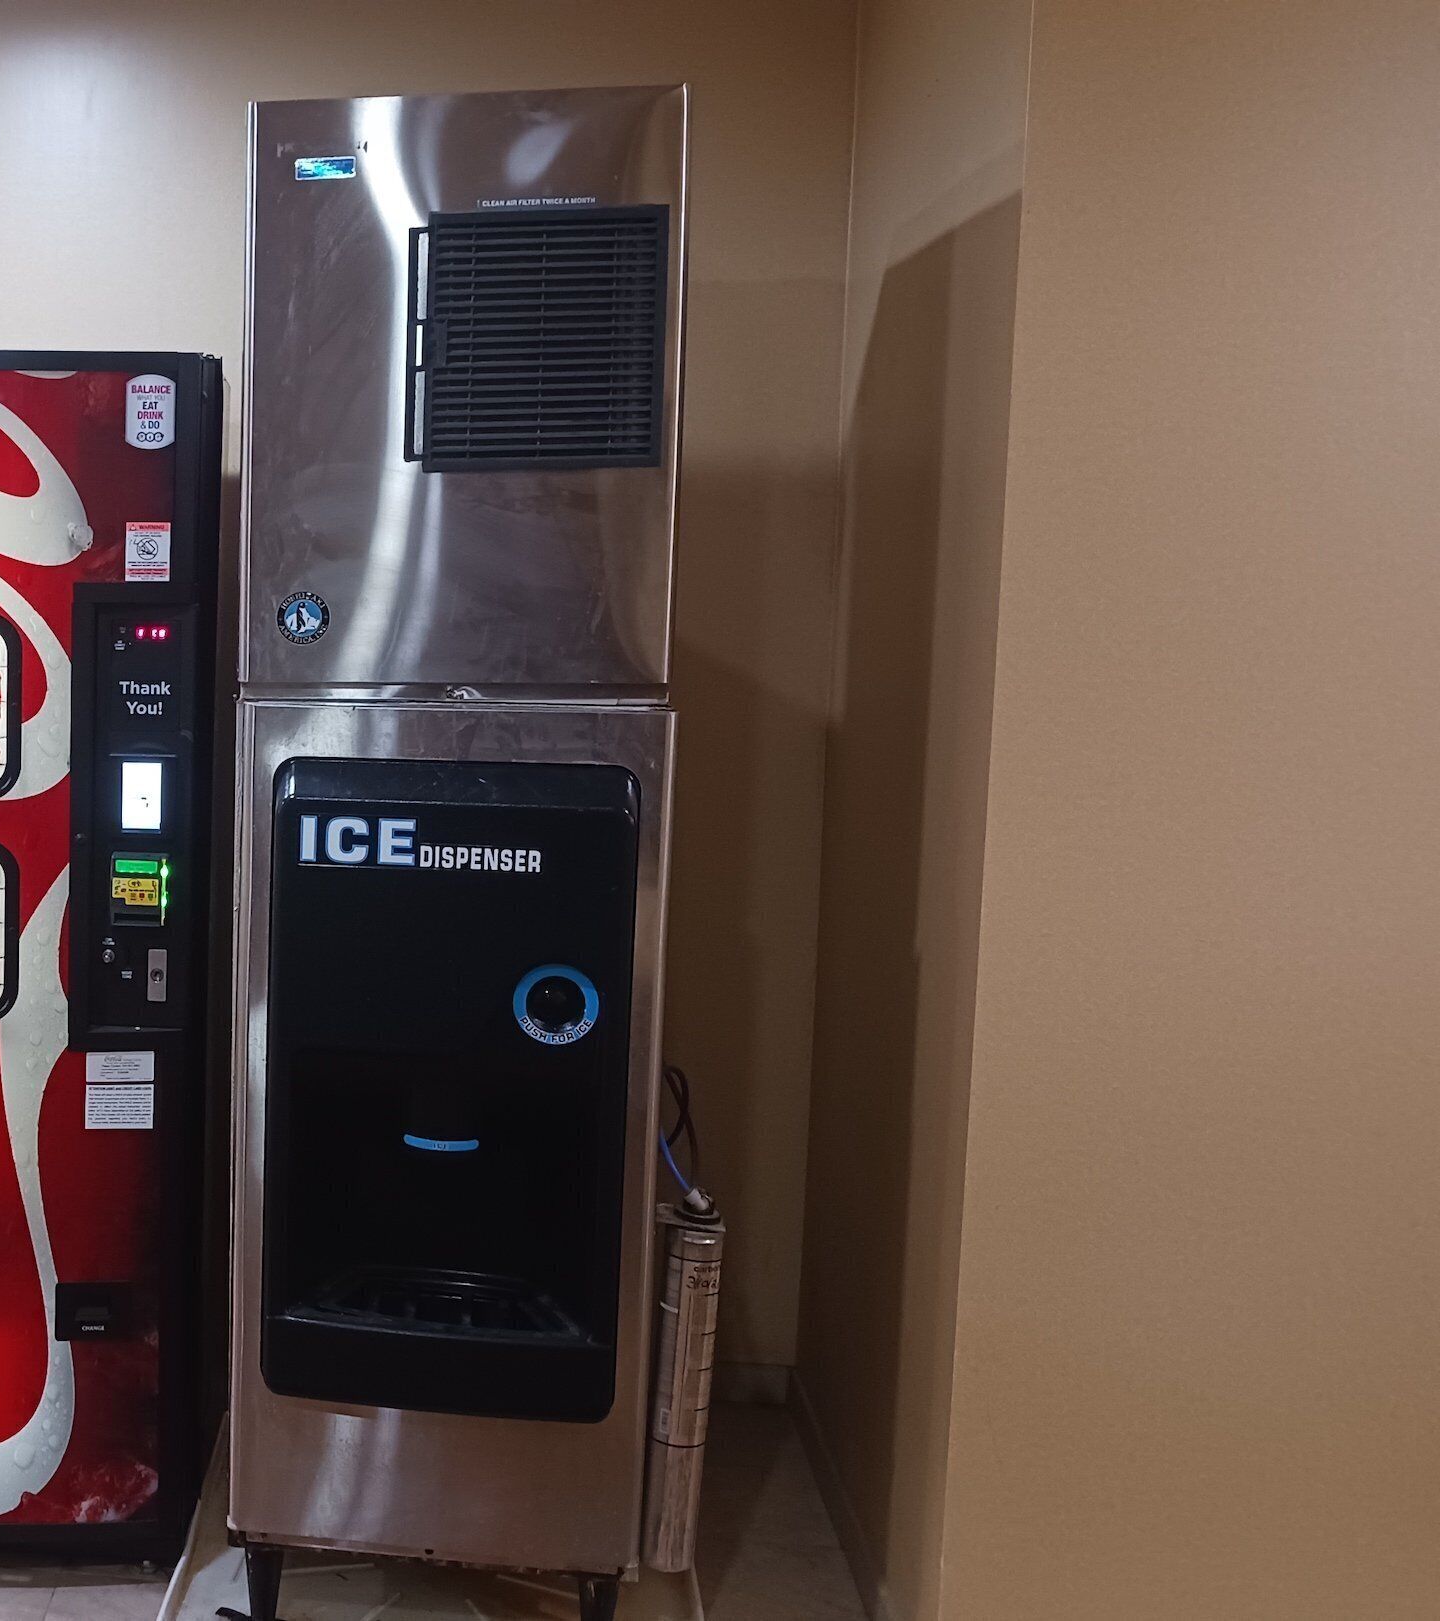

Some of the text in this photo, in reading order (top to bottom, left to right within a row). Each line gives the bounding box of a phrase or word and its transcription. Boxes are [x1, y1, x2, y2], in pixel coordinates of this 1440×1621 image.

[506, 198, 518, 206] AIR
[518, 198, 540, 206] FILTER
[131, 385, 171, 394] BALANCE
[142, 402, 158, 410] EAT
[138, 411, 164, 420] DRINK
[140, 420, 160, 429] & DO
[119, 681, 171, 695] Thank
[126, 701, 163, 715] You!
[300, 814, 542, 873] ICE DISPENSER
[520, 1016, 592, 1043] PUSH FOR ICE
